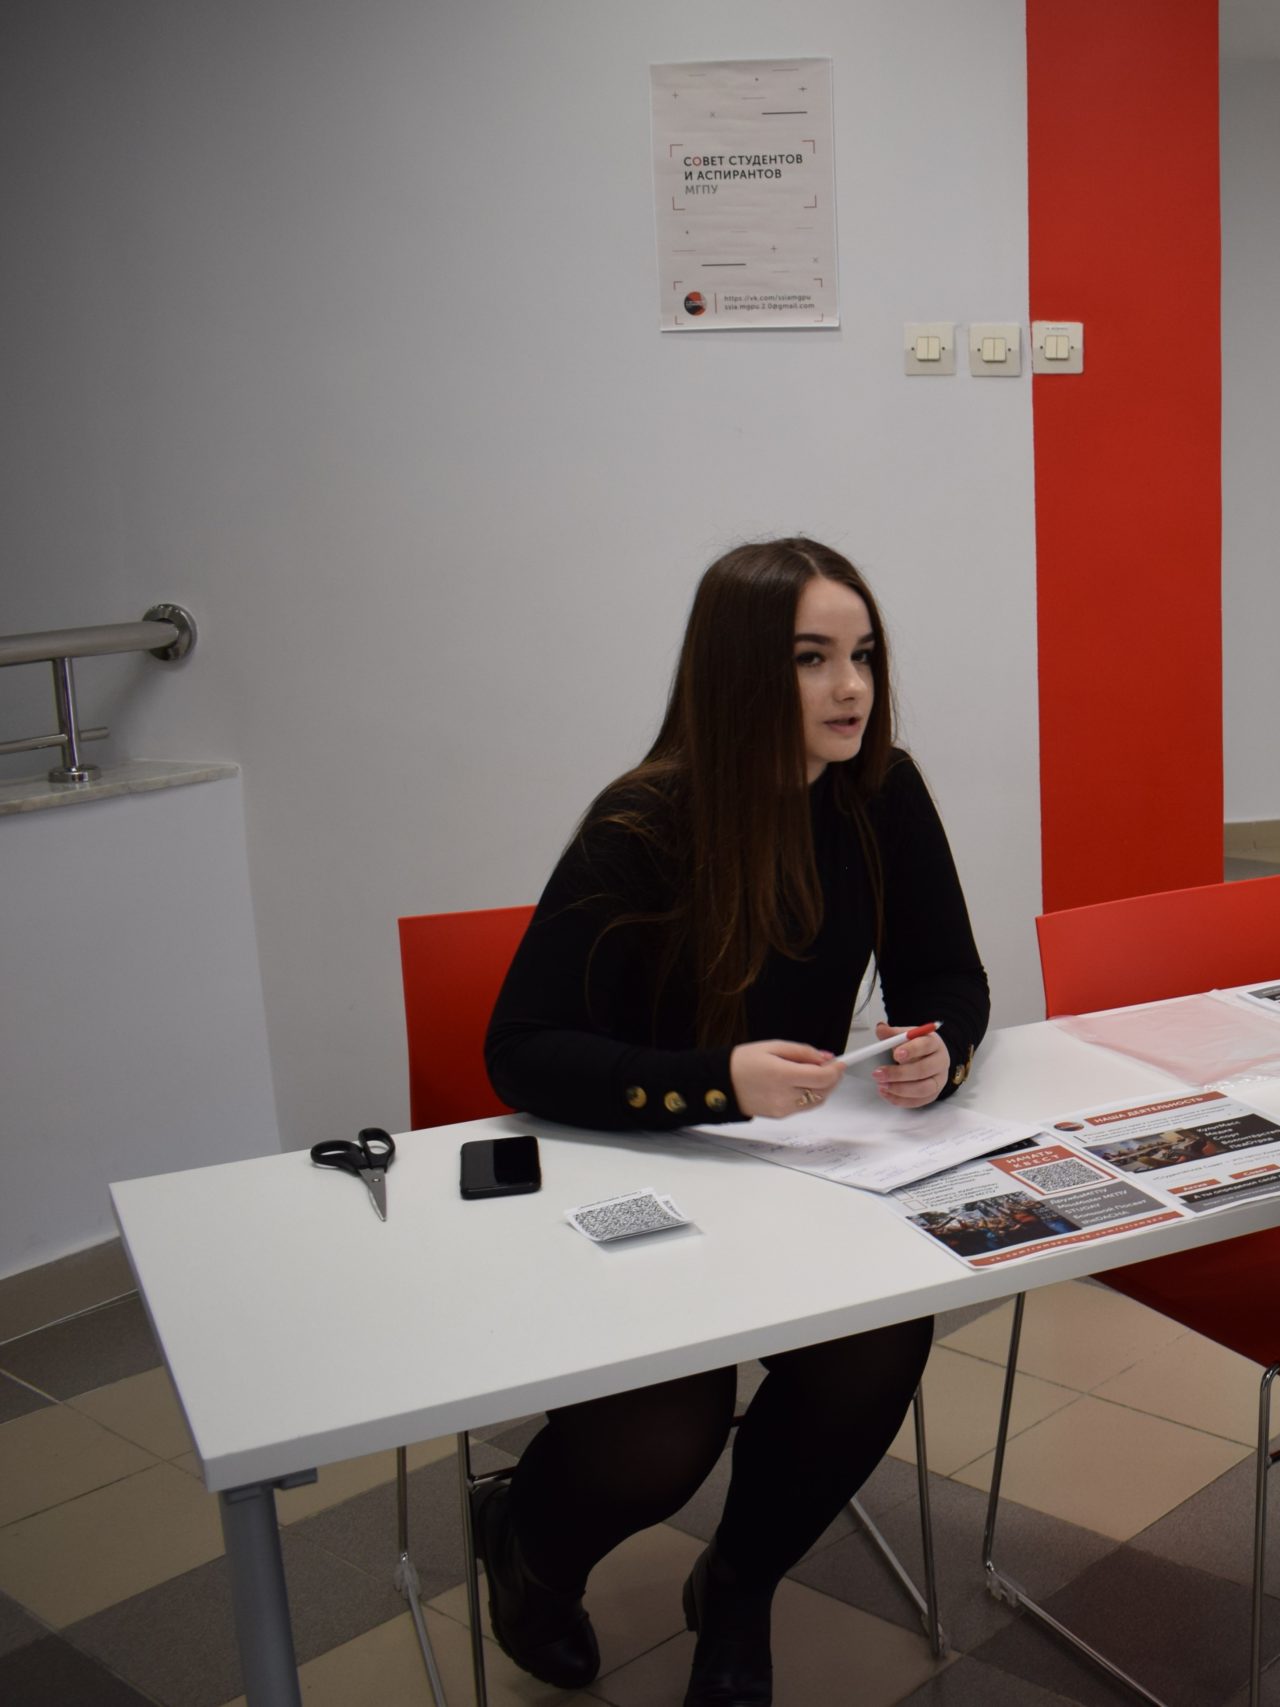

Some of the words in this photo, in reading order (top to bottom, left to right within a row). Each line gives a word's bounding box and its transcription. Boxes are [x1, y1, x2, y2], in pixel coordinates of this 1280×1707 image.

[683, 156, 725, 167] СОВЕТ
[728, 154, 803, 166] СТУДЕНТОВ
[684, 171, 693, 181] И
[697, 169, 782, 181] АСПИРАНТОВ
[685, 185, 718, 195] МГПУ
[1094, 1113, 1126, 1124] НАША
[1128, 1096, 1204, 1118] ДЕЯТЕЛЬНОСТЬ
[1006, 1151, 1053, 1164] НАЧАТЬ
[1013, 1154, 1059, 1168] КВЕСТ
